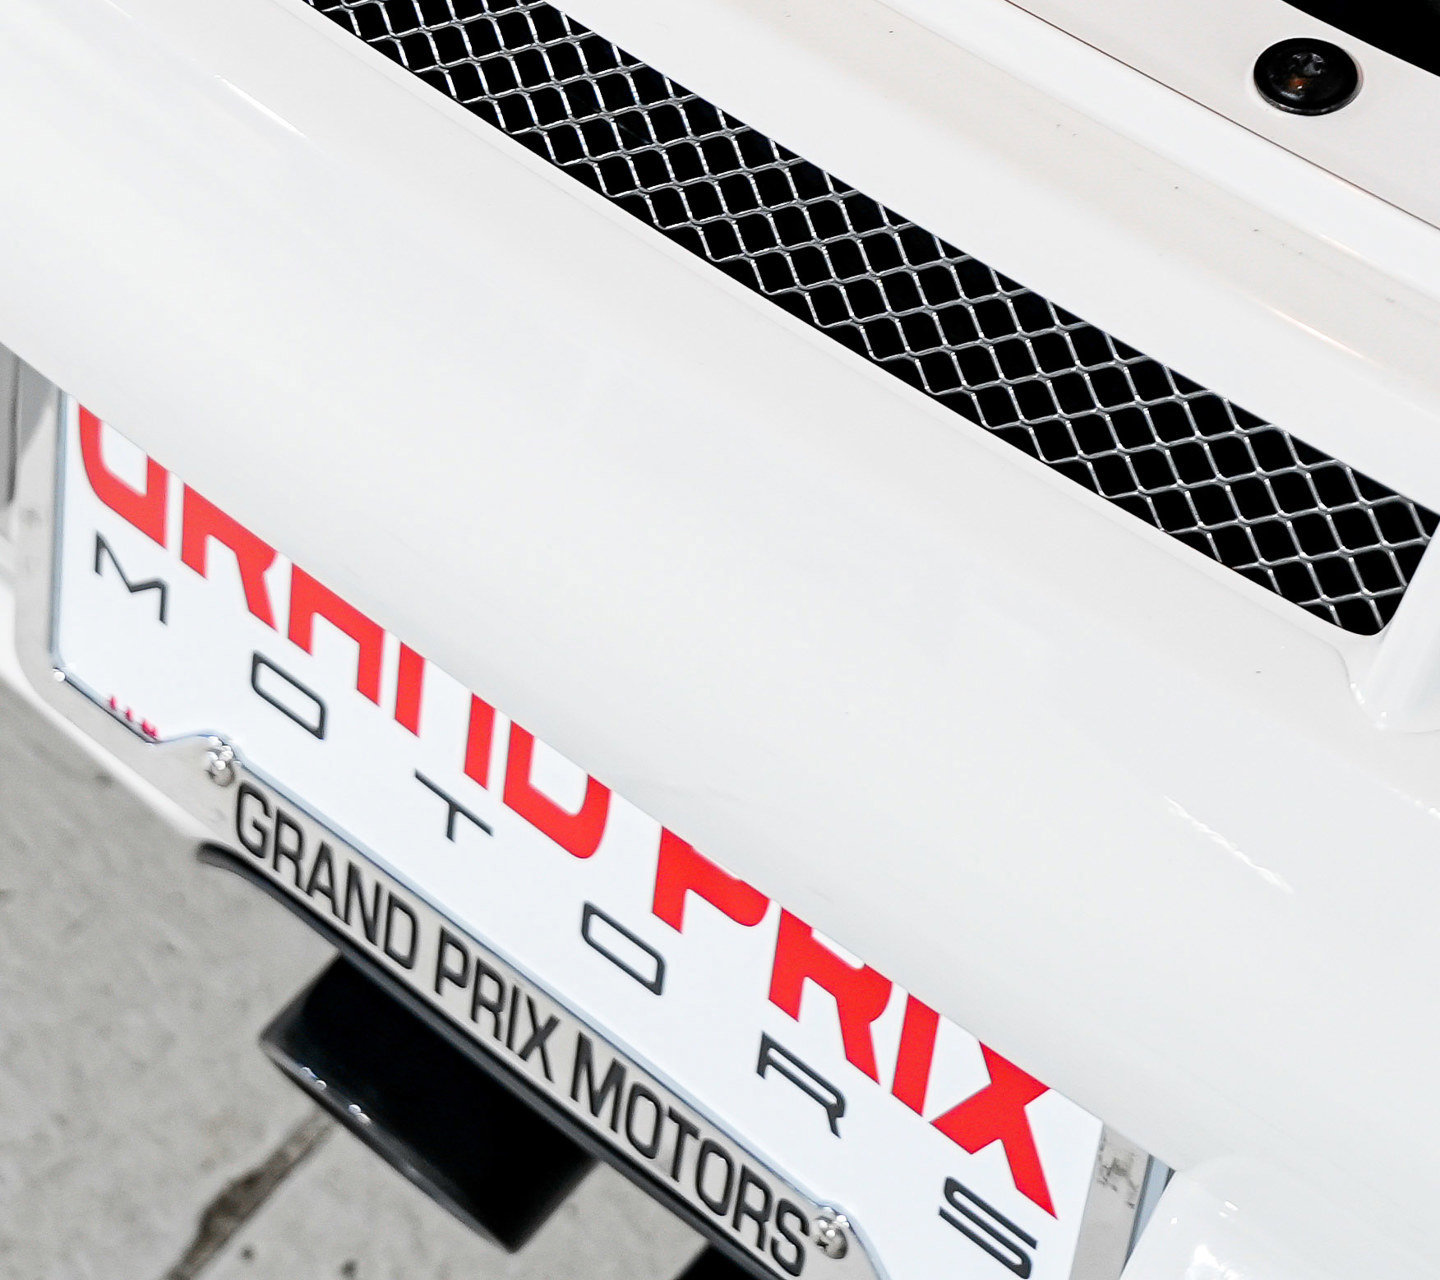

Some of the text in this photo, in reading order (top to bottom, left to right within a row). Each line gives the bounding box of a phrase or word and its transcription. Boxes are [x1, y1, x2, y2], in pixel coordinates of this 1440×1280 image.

[234, 784, 812, 1278] GRAND PRIX MOTORS
